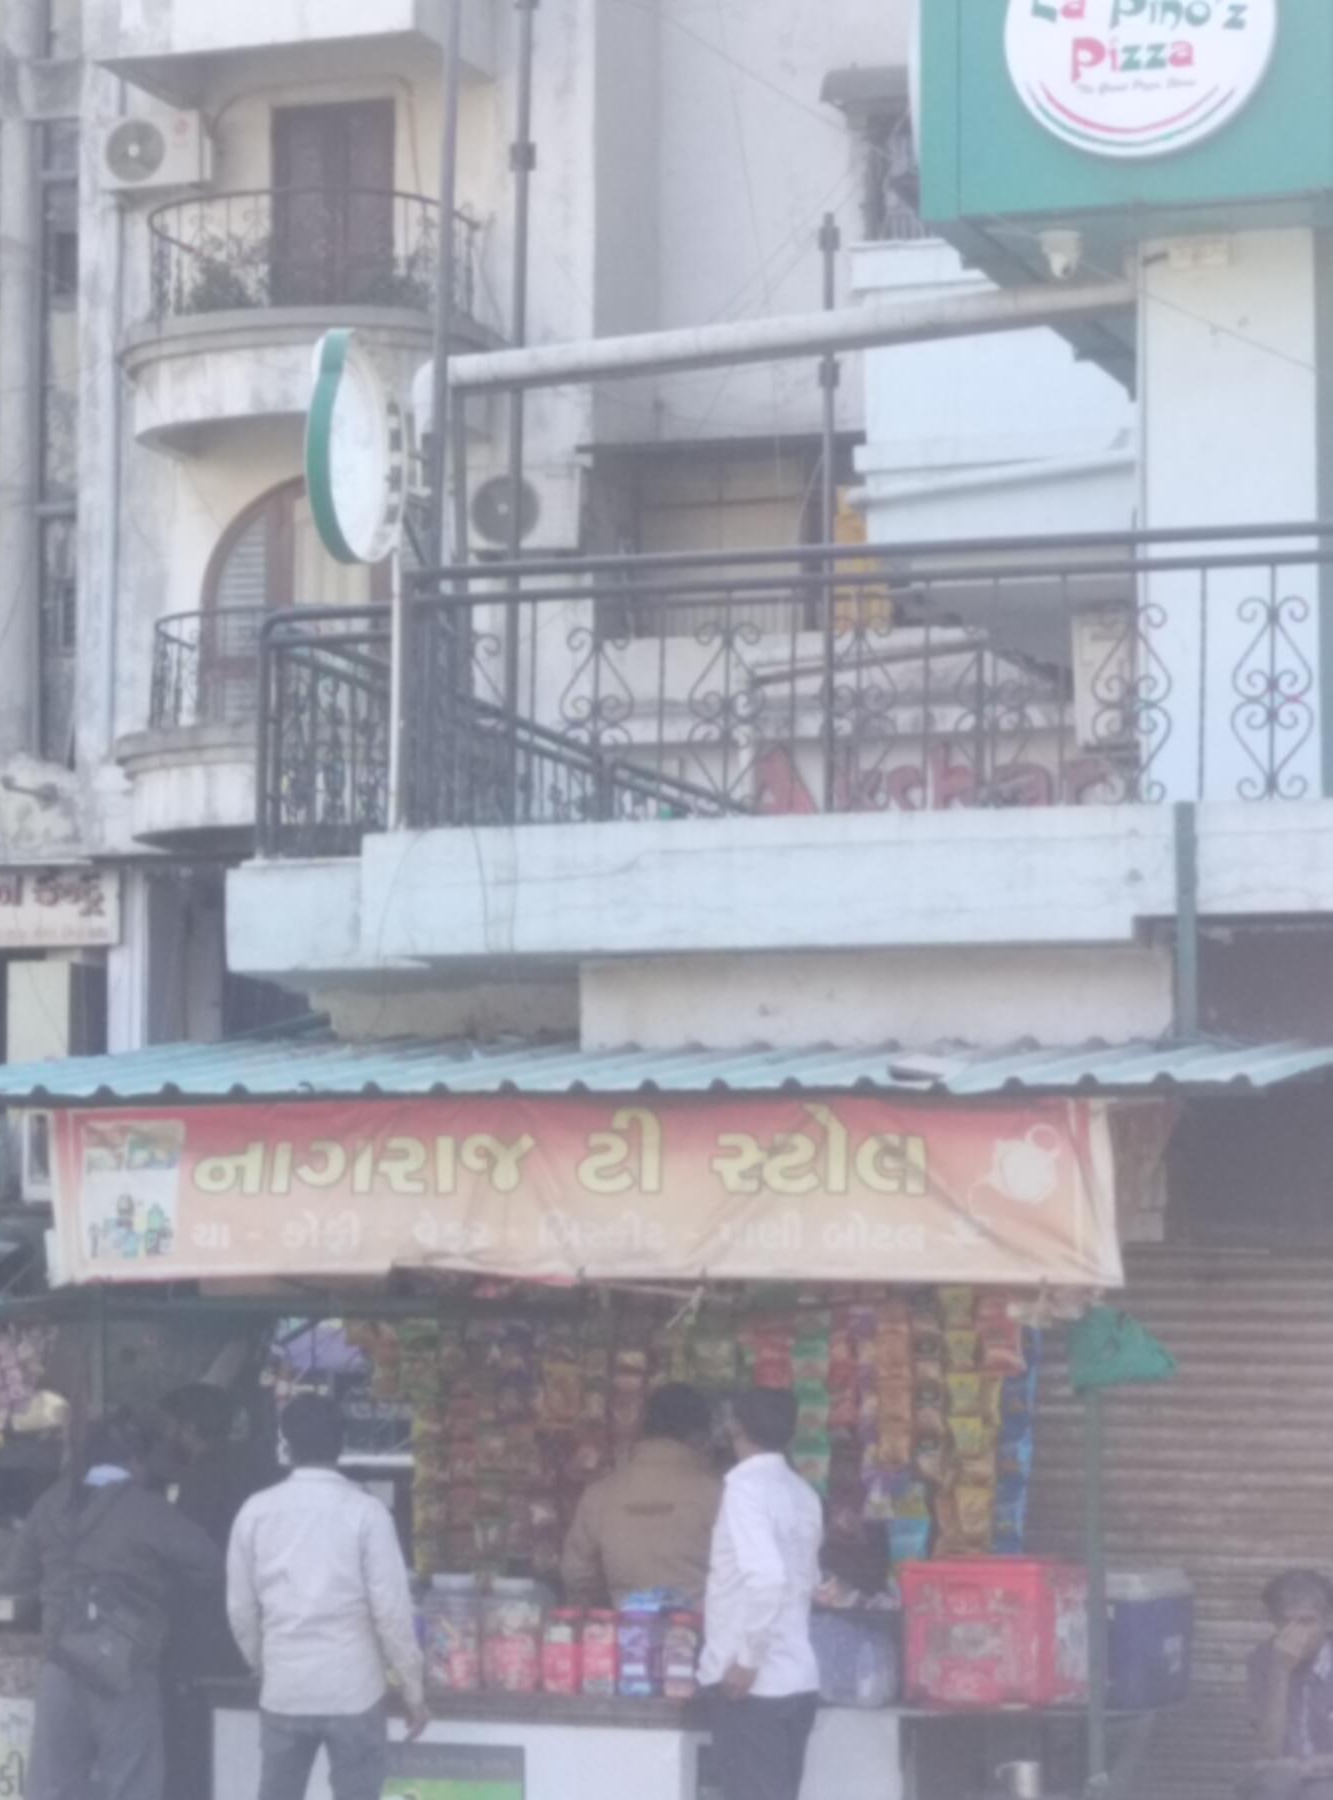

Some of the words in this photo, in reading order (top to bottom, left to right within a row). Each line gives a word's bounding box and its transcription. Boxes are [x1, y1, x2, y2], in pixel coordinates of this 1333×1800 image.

[1070, 34, 1196, 83] Pizza
[191, 1133, 536, 1197] નાગરાજ
[575, 1106, 665, 1196] ટી
[708, 1102, 929, 1196] સ્ટોલ
[190, 1221, 231, 1250] ચા
